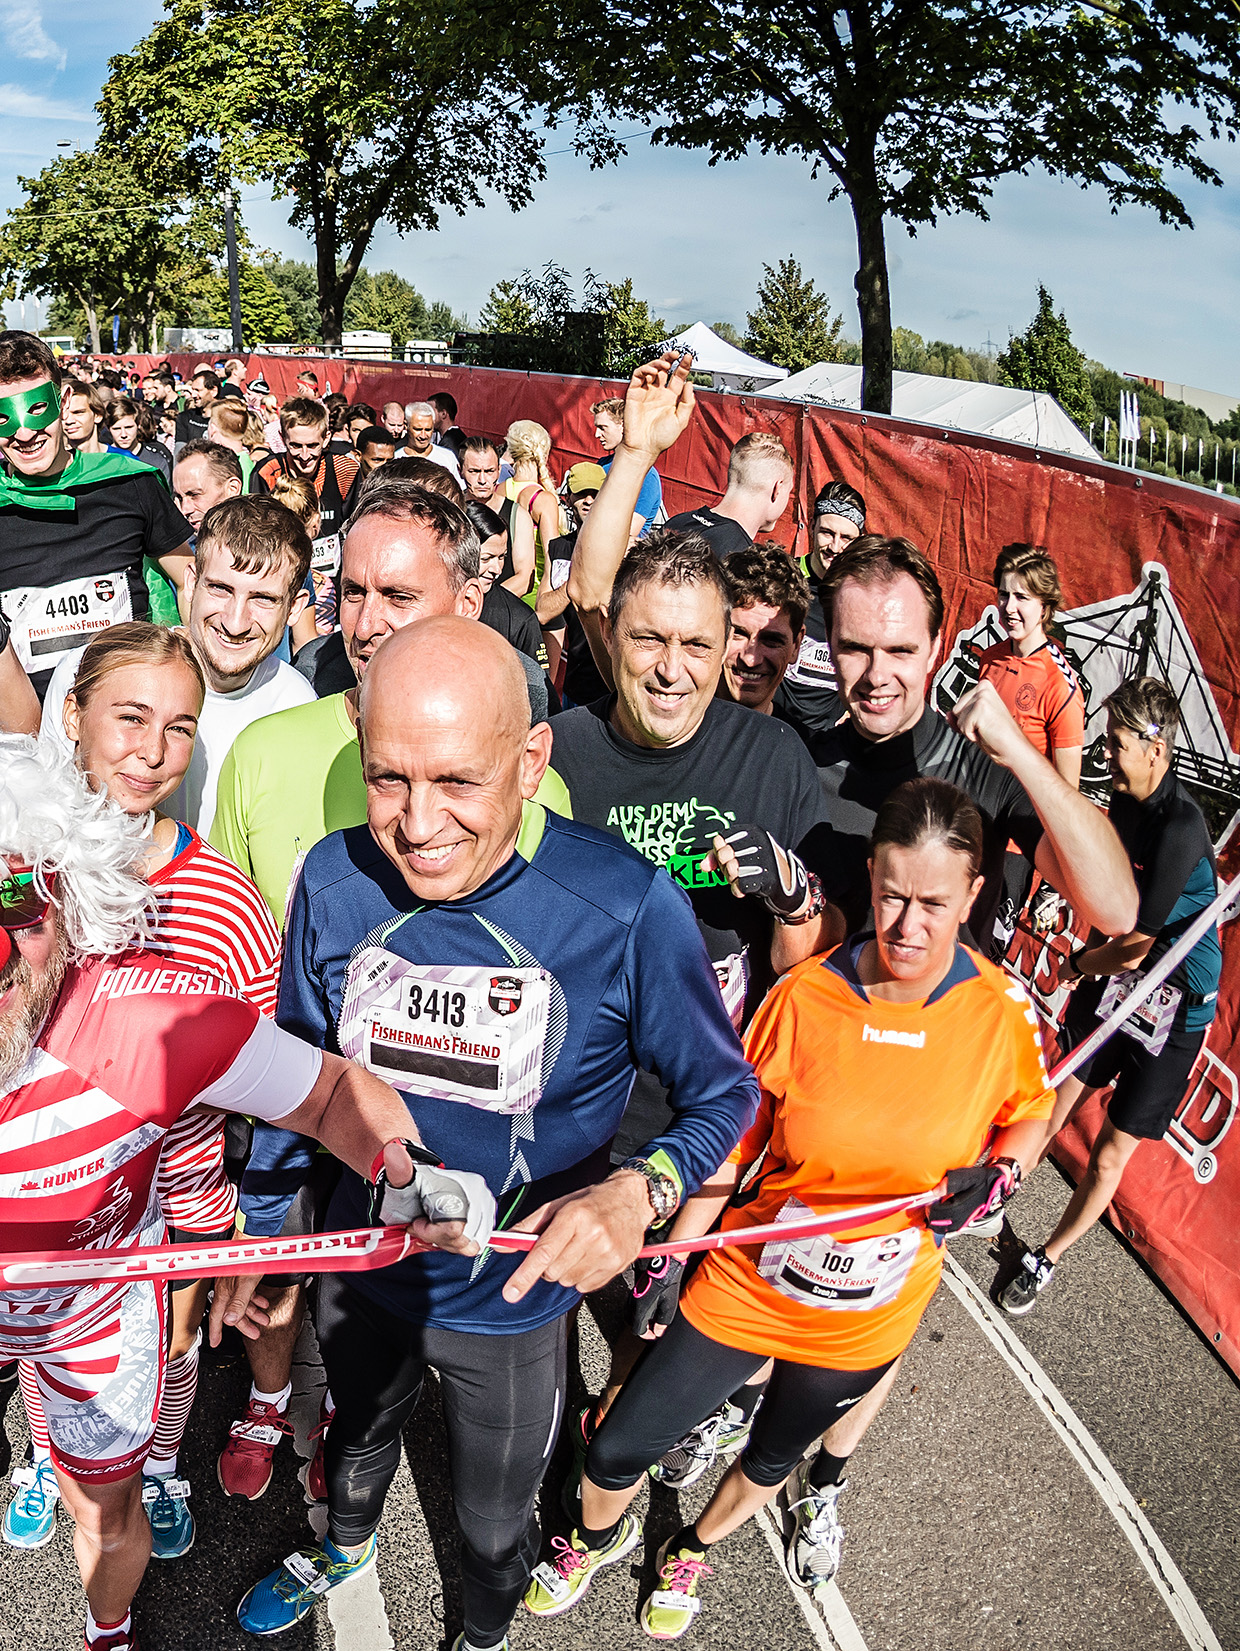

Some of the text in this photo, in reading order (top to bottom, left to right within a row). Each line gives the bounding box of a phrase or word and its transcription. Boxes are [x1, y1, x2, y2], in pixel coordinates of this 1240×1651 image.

[45, 594, 89, 618] 4403
[28, 619, 111, 638] FISHERMAN'S FRIEND
[814, 649, 831, 663] 136
[607, 801, 690, 826] AUS DEM
[620, 818, 677, 844] WEG
[91, 966, 249, 1004] POWERSLIDE
[408, 985, 466, 1028] 3413
[371, 1021, 501, 1059] FISHERMAN'S FRIEND
[43, 1157, 105, 1189] HUNTER
[786, 1253, 879, 1287] FISHERMAN'S FRIEND
[821, 1251, 855, 1274] 109
[812, 1285, 839, 1299] Svenja
